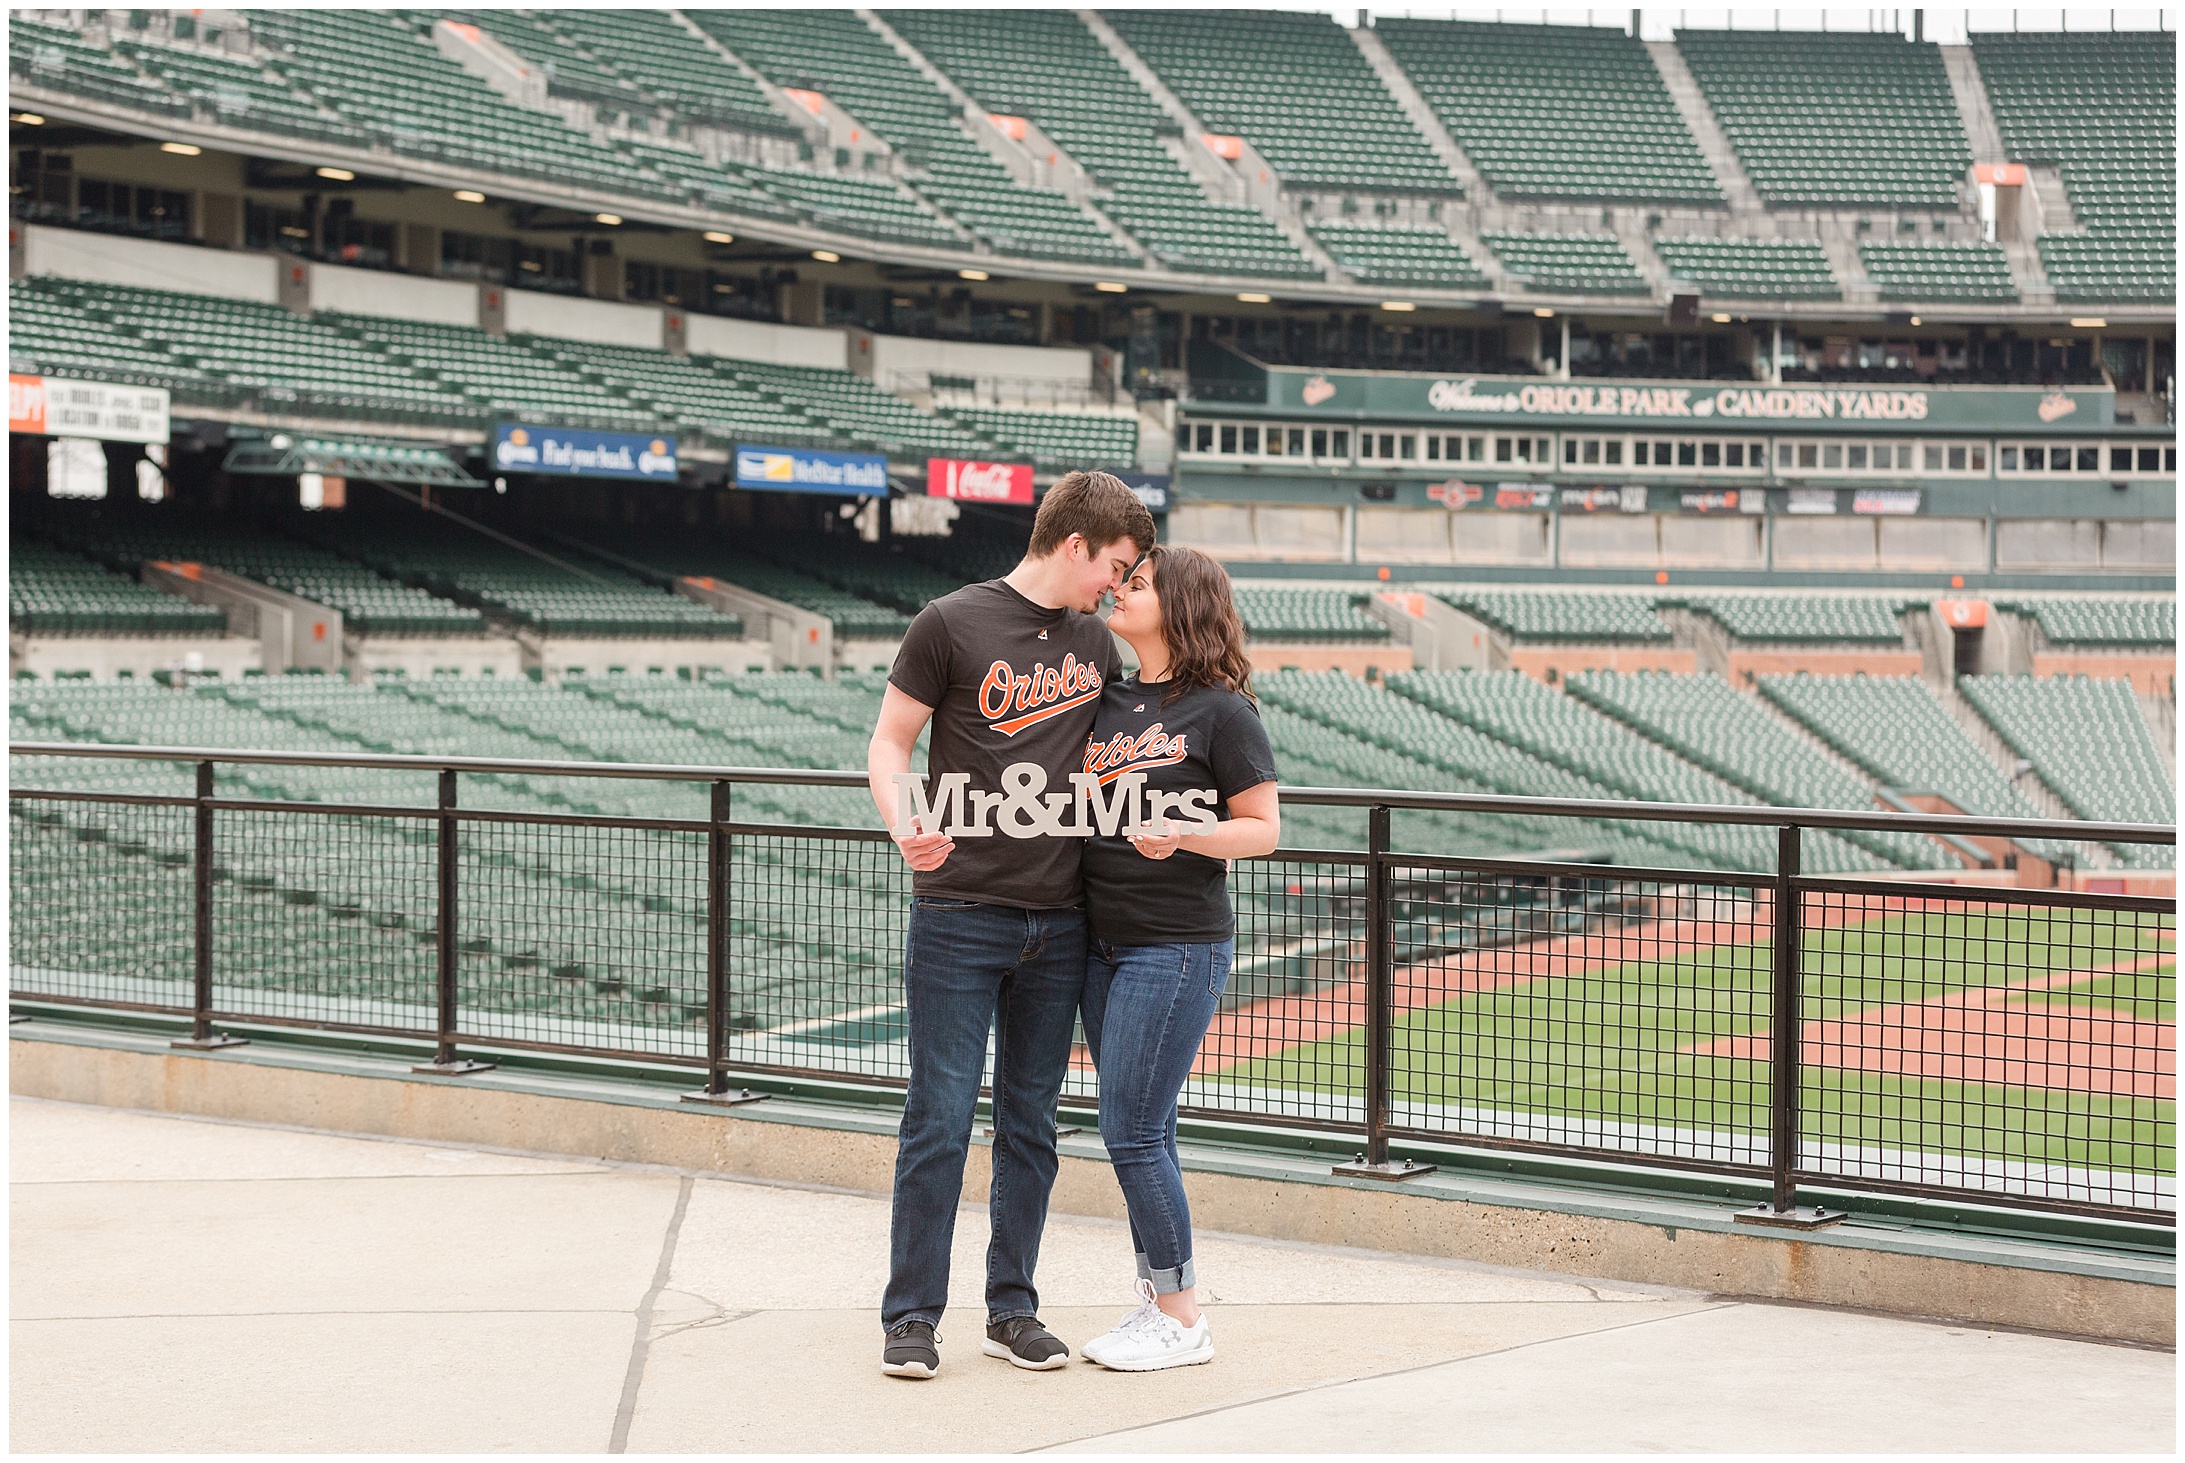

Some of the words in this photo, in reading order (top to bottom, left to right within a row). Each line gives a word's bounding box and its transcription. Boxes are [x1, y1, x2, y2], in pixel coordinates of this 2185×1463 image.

[1520, 385, 1618, 414] ORIOLE
[1619, 388, 1692, 416] PARK
[1716, 389, 1836, 418] CAMDEN
[1836, 391, 1928, 420] YARDS
[979, 652, 1101, 720] Orioles
